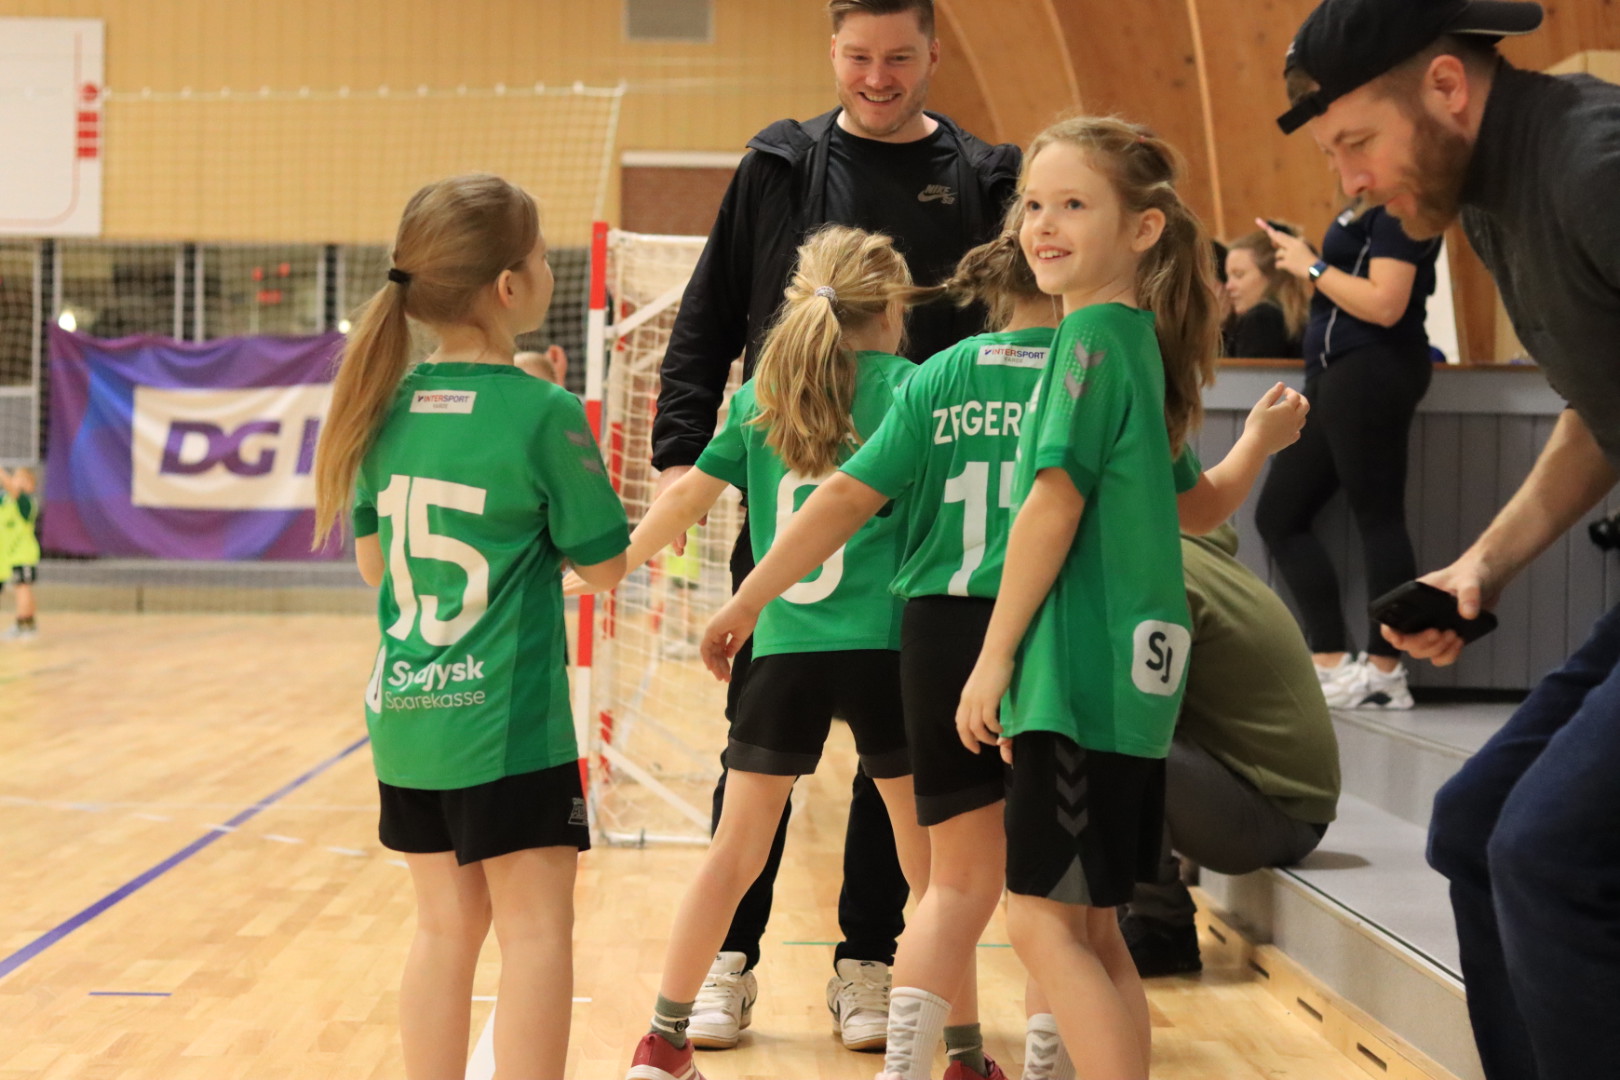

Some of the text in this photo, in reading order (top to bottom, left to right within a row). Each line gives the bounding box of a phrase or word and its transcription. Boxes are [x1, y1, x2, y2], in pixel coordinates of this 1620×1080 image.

[992, 349, 1044, 359] INTERSPORT
[423, 395, 469, 403] INTERSPORT
[933, 400, 1031, 445] ZEGER
[160, 416, 320, 477] DGI
[944, 461, 1016, 596] 1
[377, 474, 489, 646] 15
[384, 691, 486, 712] Sparekasse
